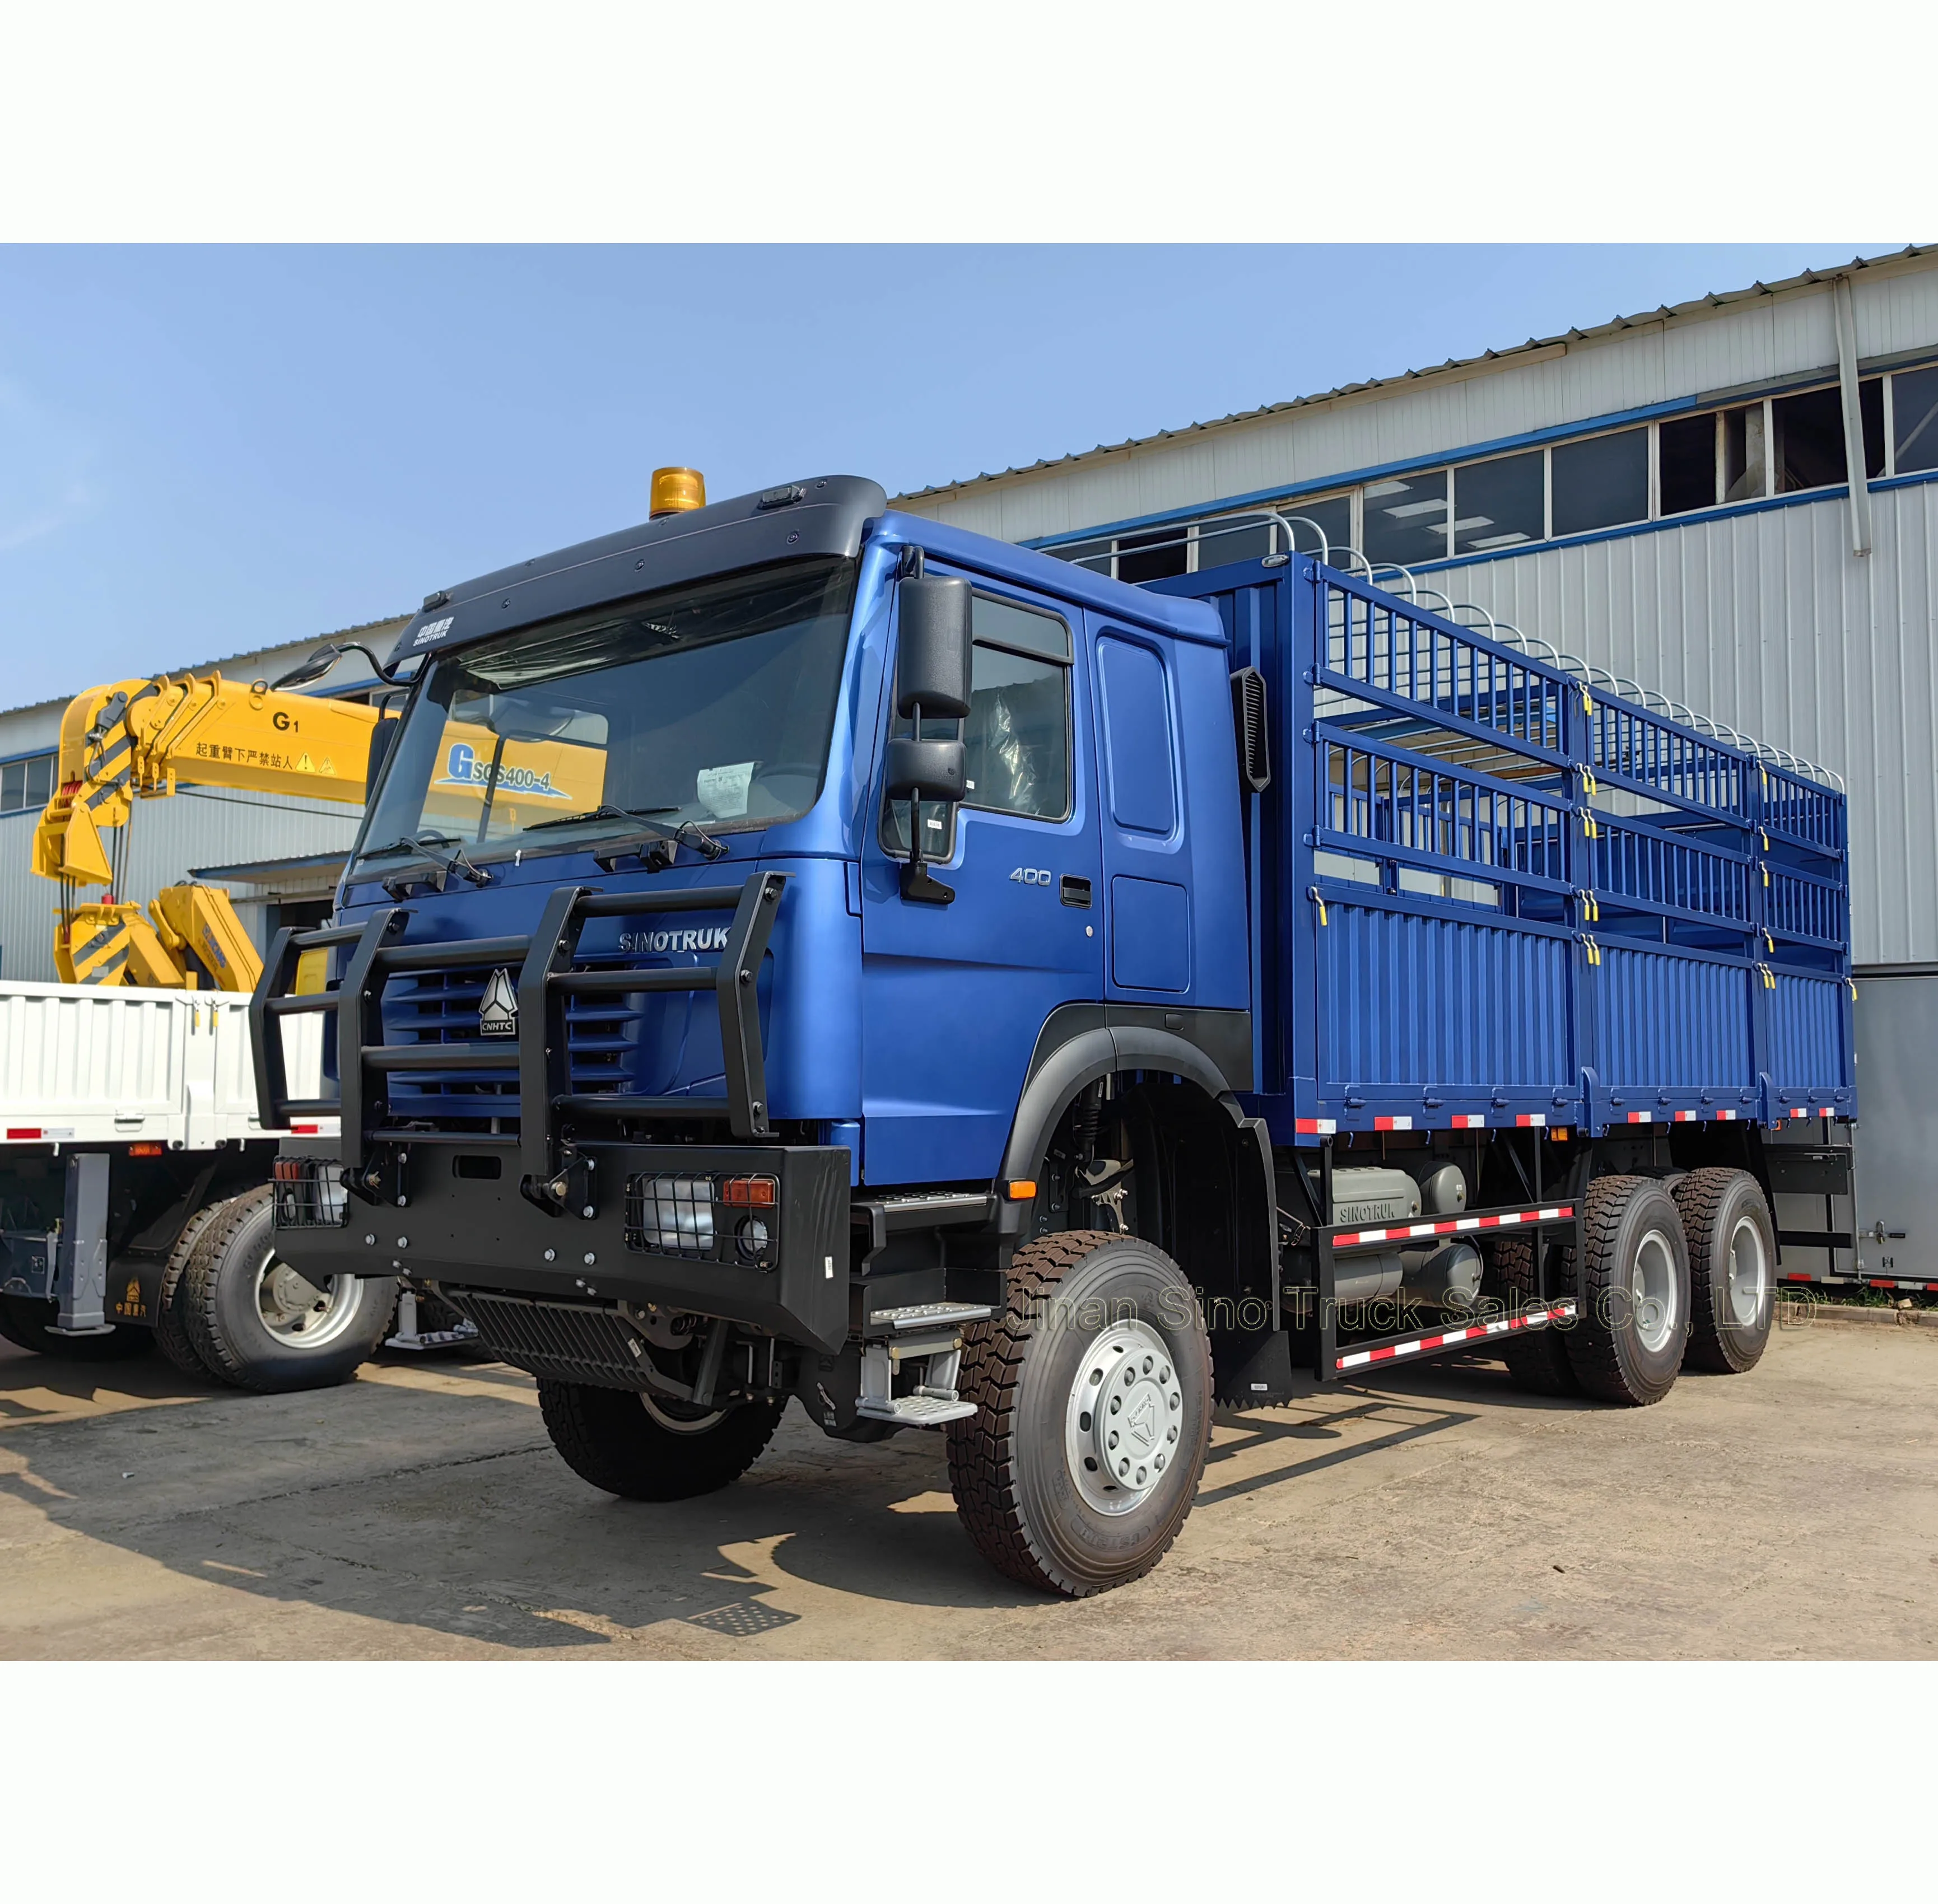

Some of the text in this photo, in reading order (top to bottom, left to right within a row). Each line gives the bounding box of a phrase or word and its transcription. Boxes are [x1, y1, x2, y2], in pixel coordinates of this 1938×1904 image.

[413, 629, 448, 646] SINOTRUK
[196, 741, 292, 770] 起重臂下严禁站人
[1010, 867, 1051, 886] 400
[619, 926, 731, 952] SINOTRUK
[482, 1021, 512, 1030] CNHTC
[1340, 1202, 1395, 1223] SINOTRUK
